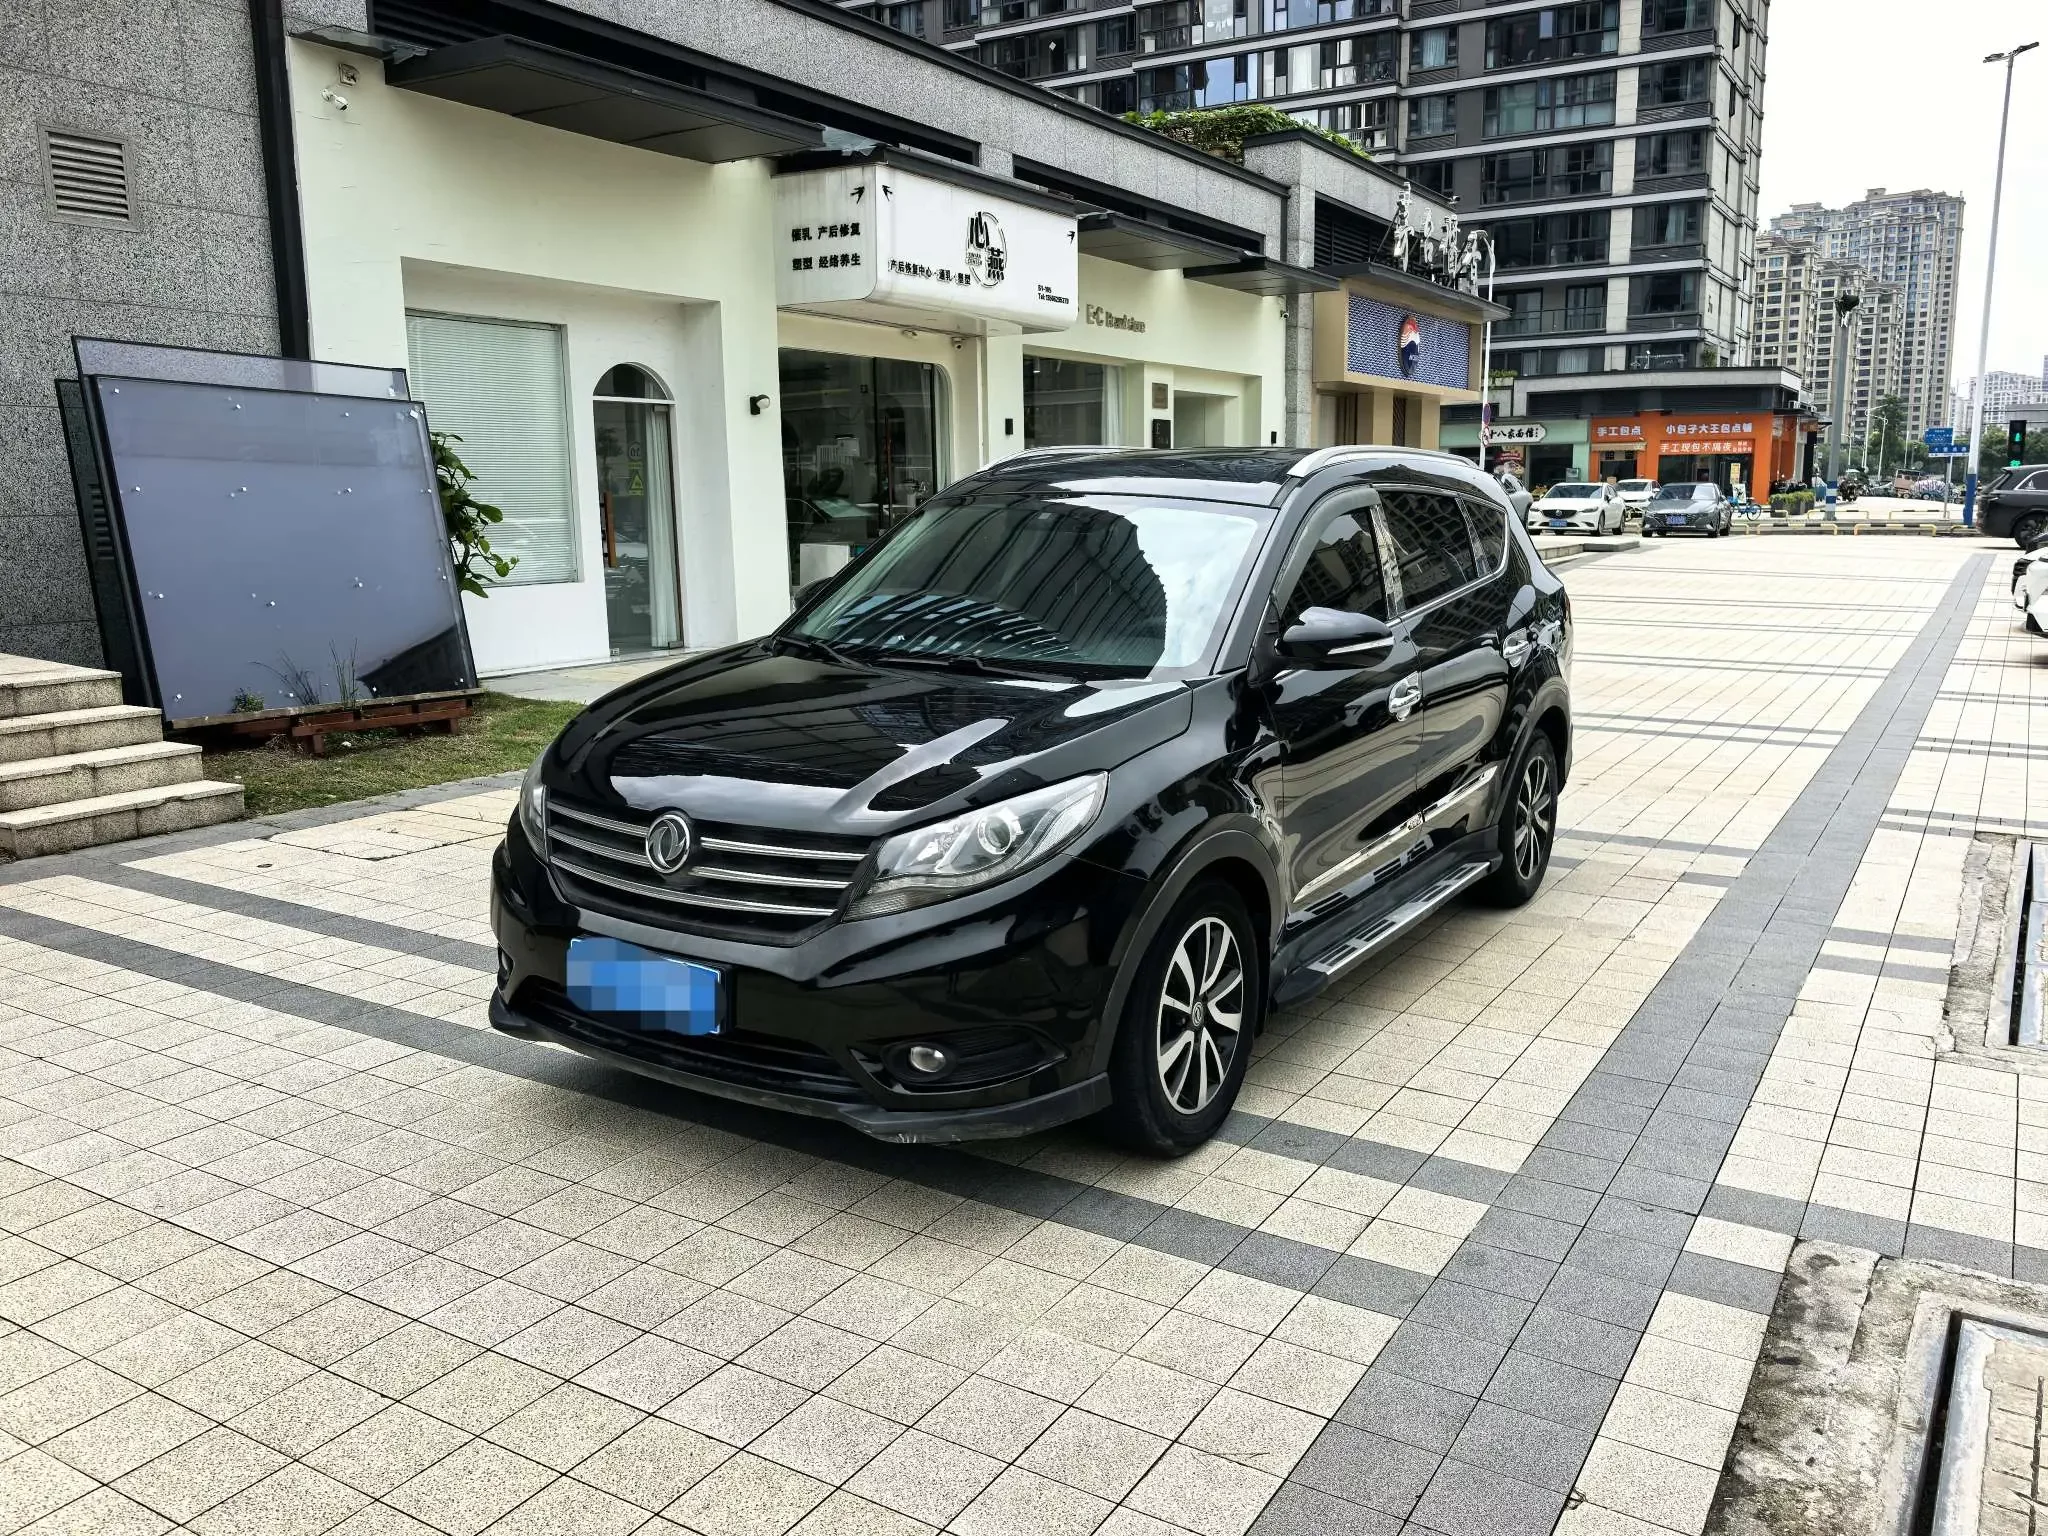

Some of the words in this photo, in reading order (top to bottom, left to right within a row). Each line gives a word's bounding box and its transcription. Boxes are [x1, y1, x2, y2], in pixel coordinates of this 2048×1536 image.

[818, 222, 861, 240] 产后修复
[818, 253, 861, 268] 经络养生
[1597, 425, 1641, 437] 手工包点
